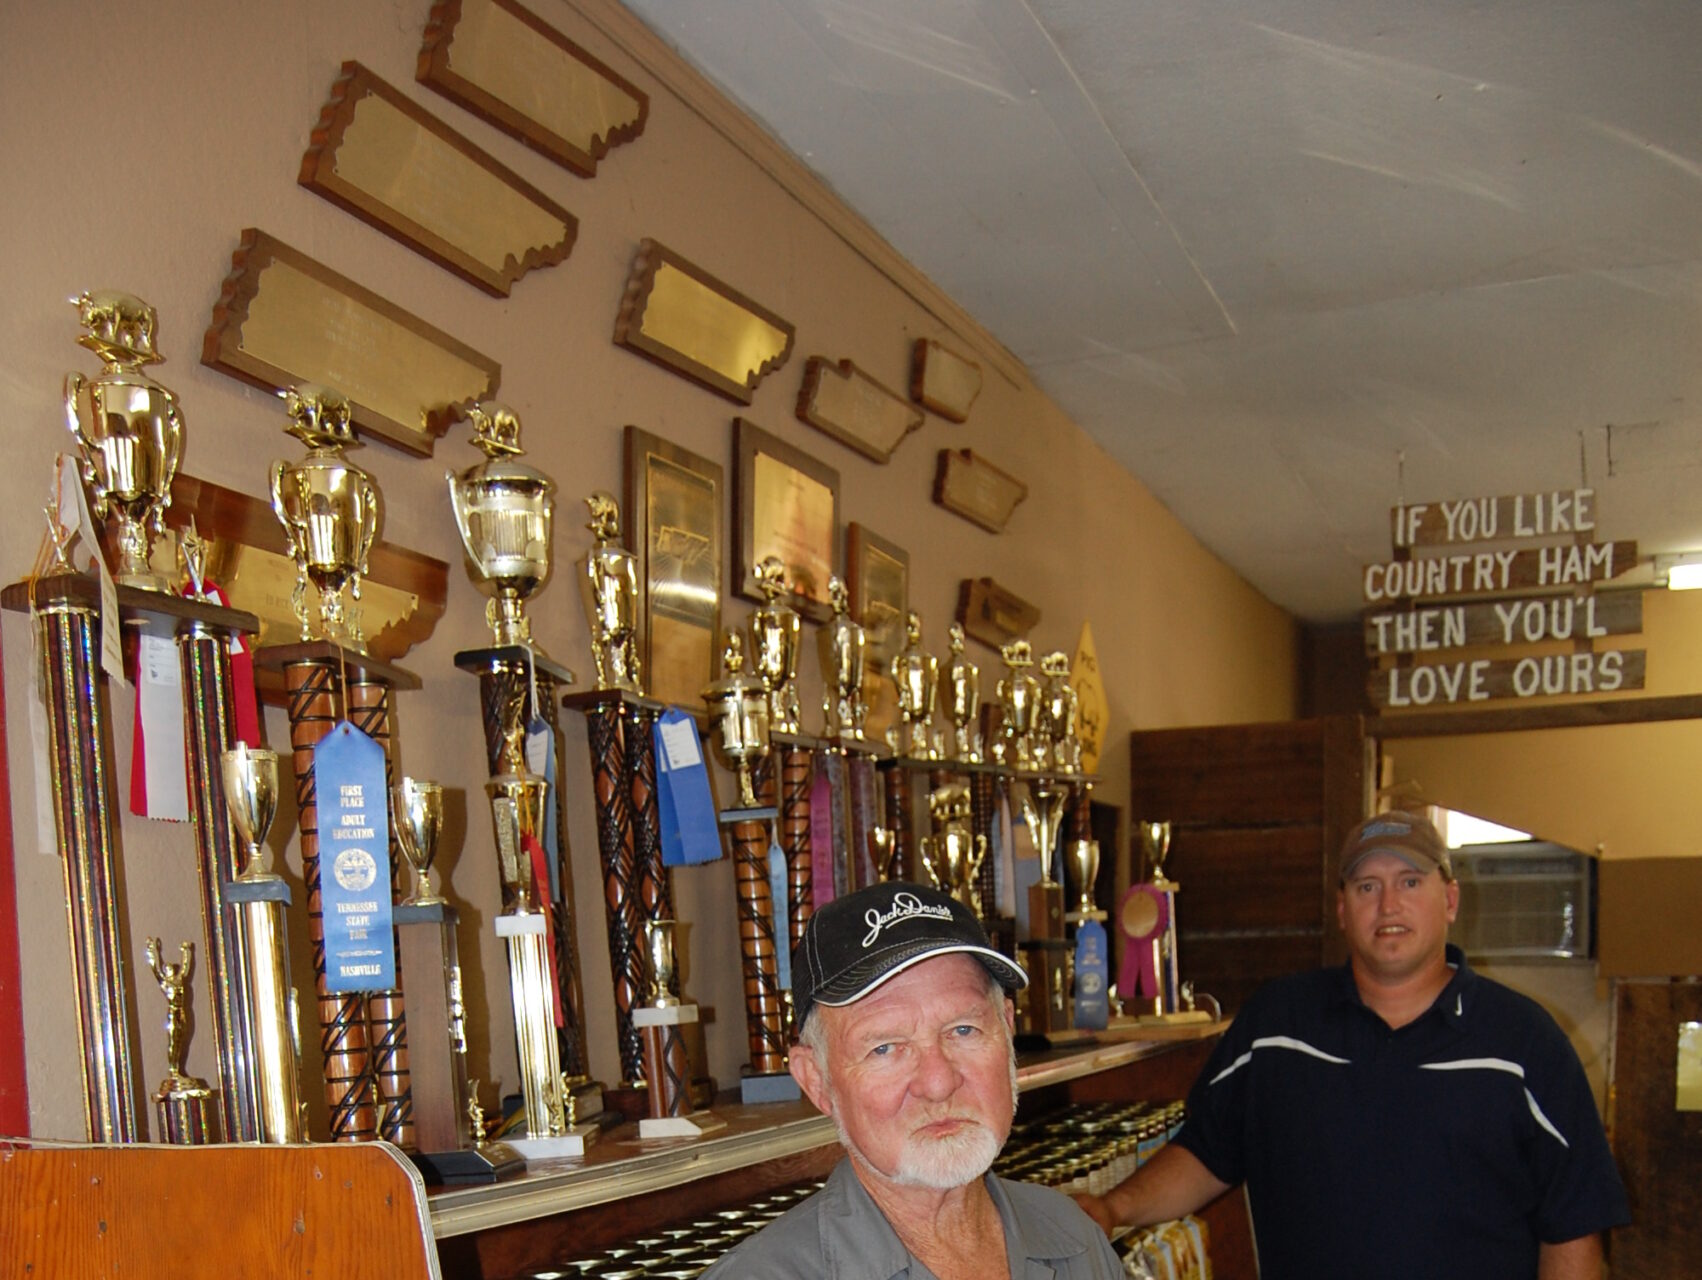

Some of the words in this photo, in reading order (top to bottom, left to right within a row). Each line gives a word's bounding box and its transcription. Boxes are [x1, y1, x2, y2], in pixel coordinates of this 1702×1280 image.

[1396, 505, 1427, 546] IF
[1440, 498, 1498, 541] YOU
[1513, 488, 1595, 537] LIKE
[1365, 550, 1516, 600] COUNTRY
[1538, 542, 1615, 586] HAM
[1371, 606, 1466, 652] THEN
[1494, 596, 1607, 644] YOU'L
[1388, 659, 1491, 707] LOVE
[1512, 651, 1624, 698] OURS
[339, 964, 382, 977] NASHVILLE
